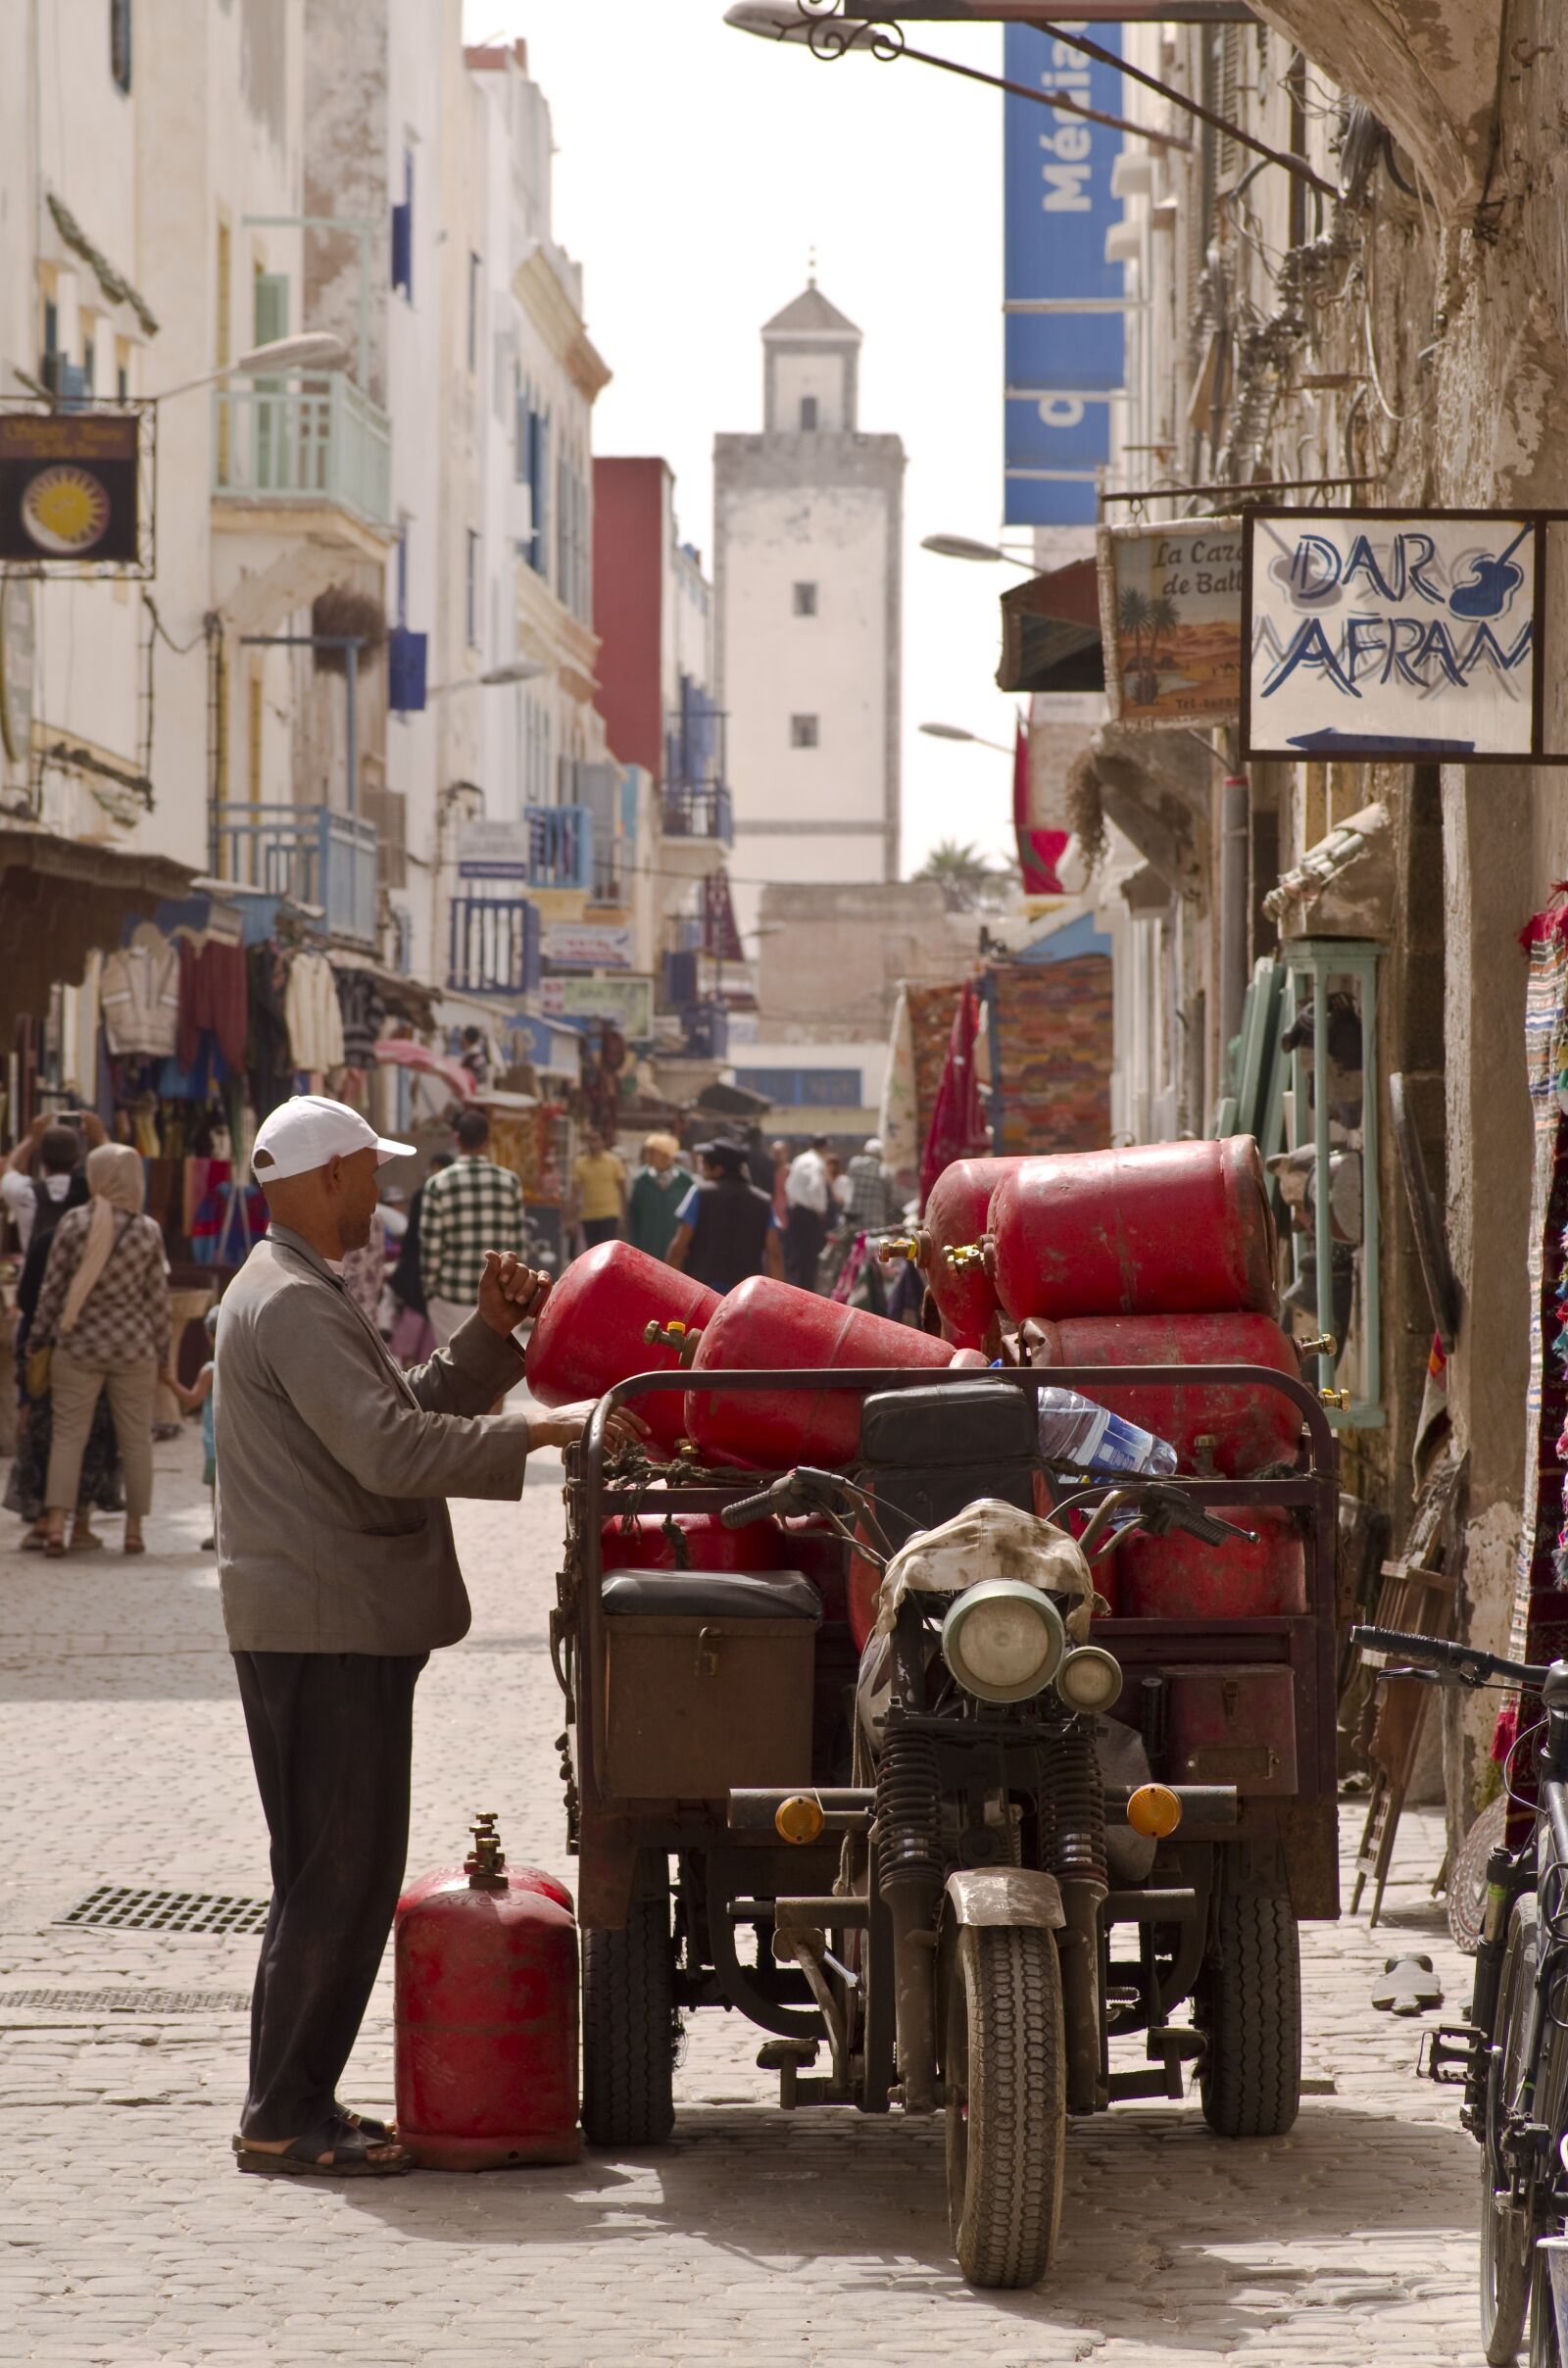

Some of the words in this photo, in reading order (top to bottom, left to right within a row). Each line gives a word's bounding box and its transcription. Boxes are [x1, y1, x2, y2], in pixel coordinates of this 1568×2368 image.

[1152, 540, 1183, 568] La
[1290, 533, 1446, 604] DAR
[1162, 572, 1191, 595] de
[1260, 614, 1535, 699] AFRAN
